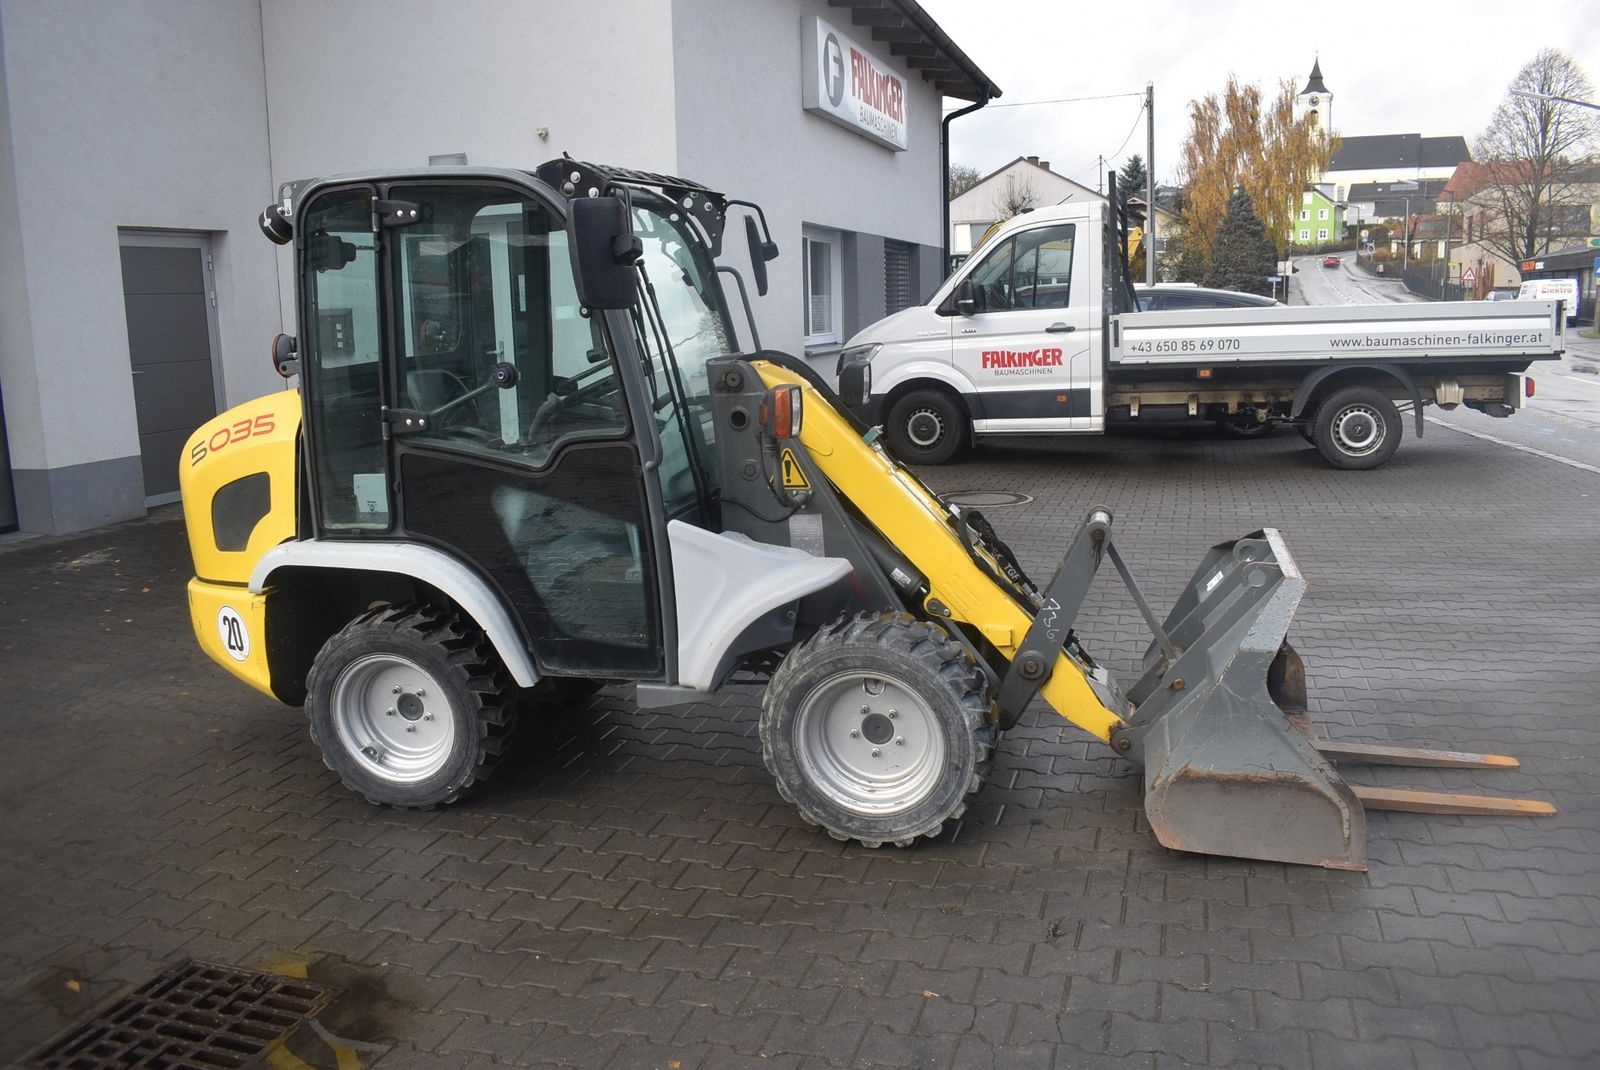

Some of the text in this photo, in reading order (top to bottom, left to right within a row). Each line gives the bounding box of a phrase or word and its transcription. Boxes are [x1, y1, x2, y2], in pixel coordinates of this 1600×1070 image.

[850, 46, 904, 125] FALKINGER
[1131, 338, 1240, 352] +43 650 85 69 070
[1330, 332, 1543, 348] www.baumaschinen-falkinger.at
[981, 348, 1063, 369] FALKINGER
[994, 367, 1053, 377] BAUMASCHINEN
[222, 615, 245, 652] 20
